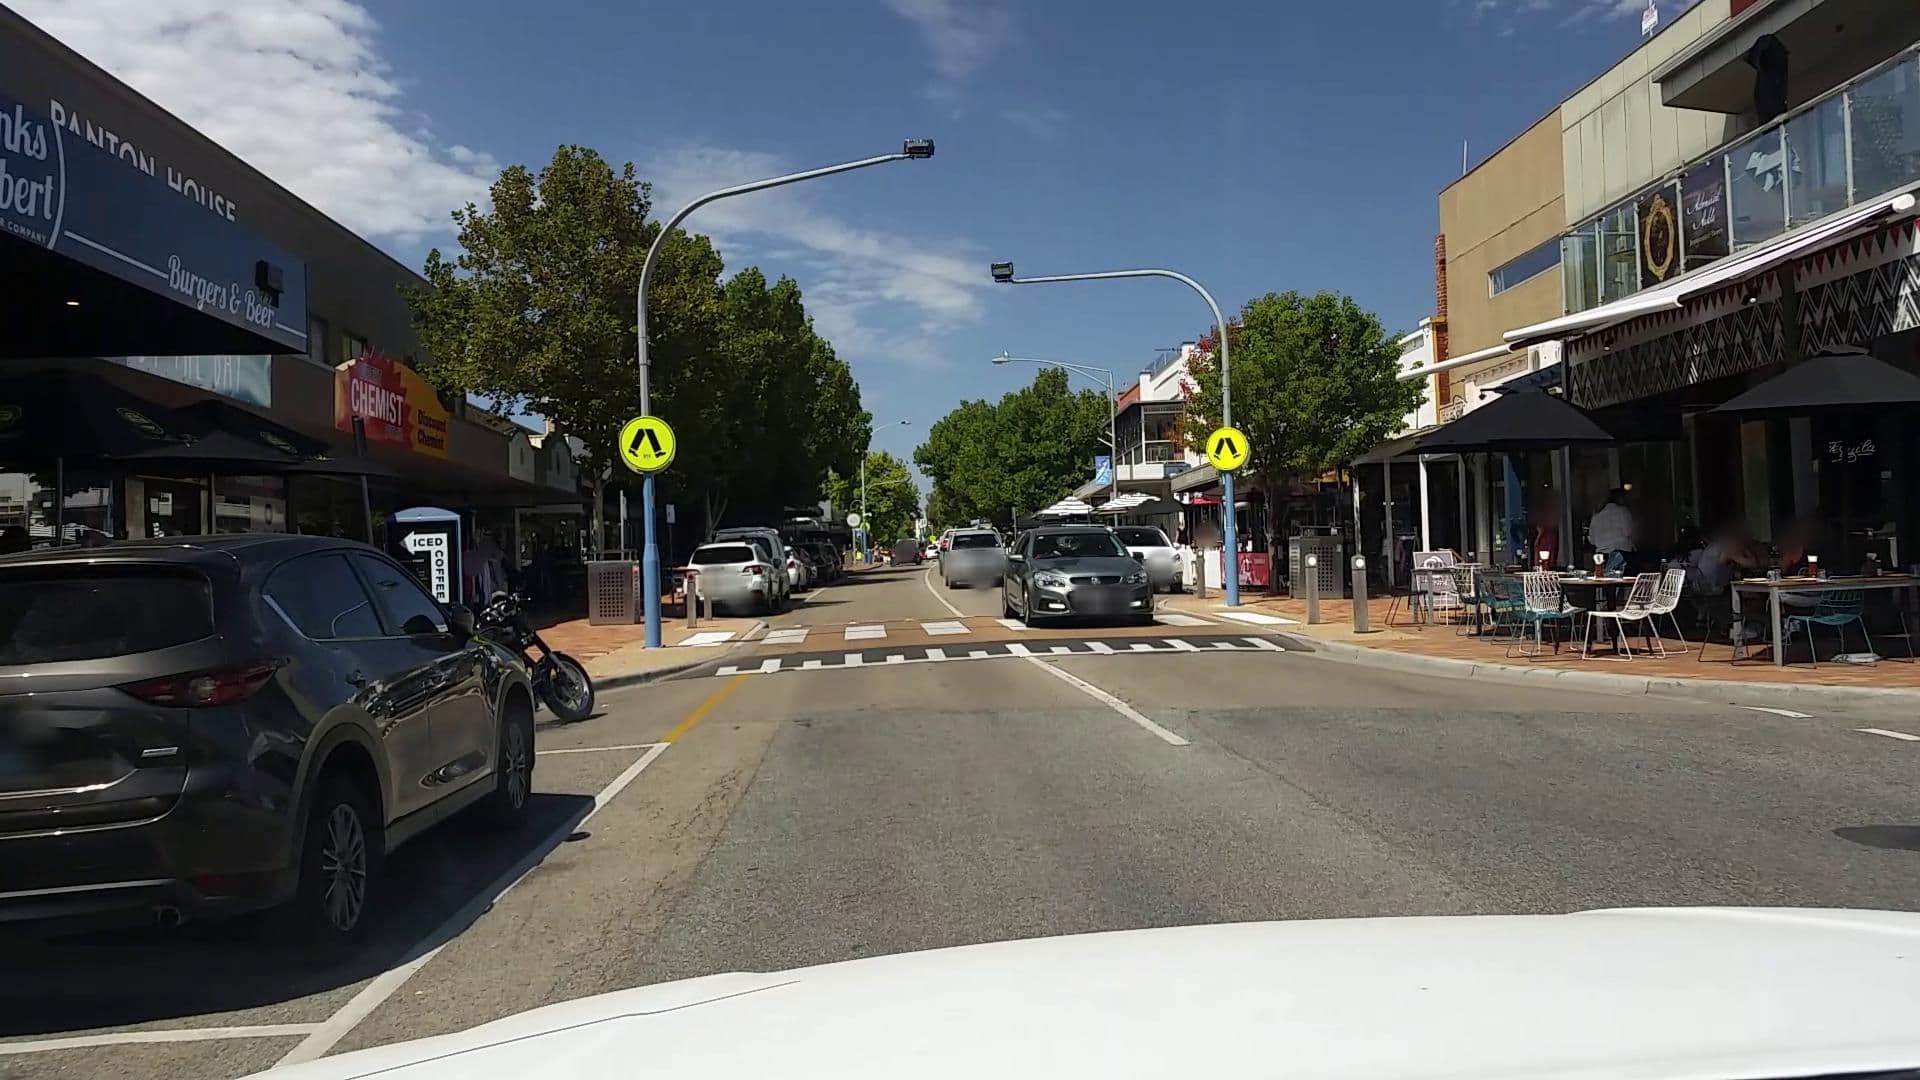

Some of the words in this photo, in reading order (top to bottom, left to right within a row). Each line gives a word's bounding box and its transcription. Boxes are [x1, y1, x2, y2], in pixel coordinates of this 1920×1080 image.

[7, 220, 48, 246] COMPANY
[167, 254, 227, 311] Burgers
[229, 283, 242, 315] &
[244, 289, 275, 329] Beer
[351, 378, 405, 426] CHEMIST
[413, 537, 443, 548] ICED
[434, 550, 446, 600] COFFEE
